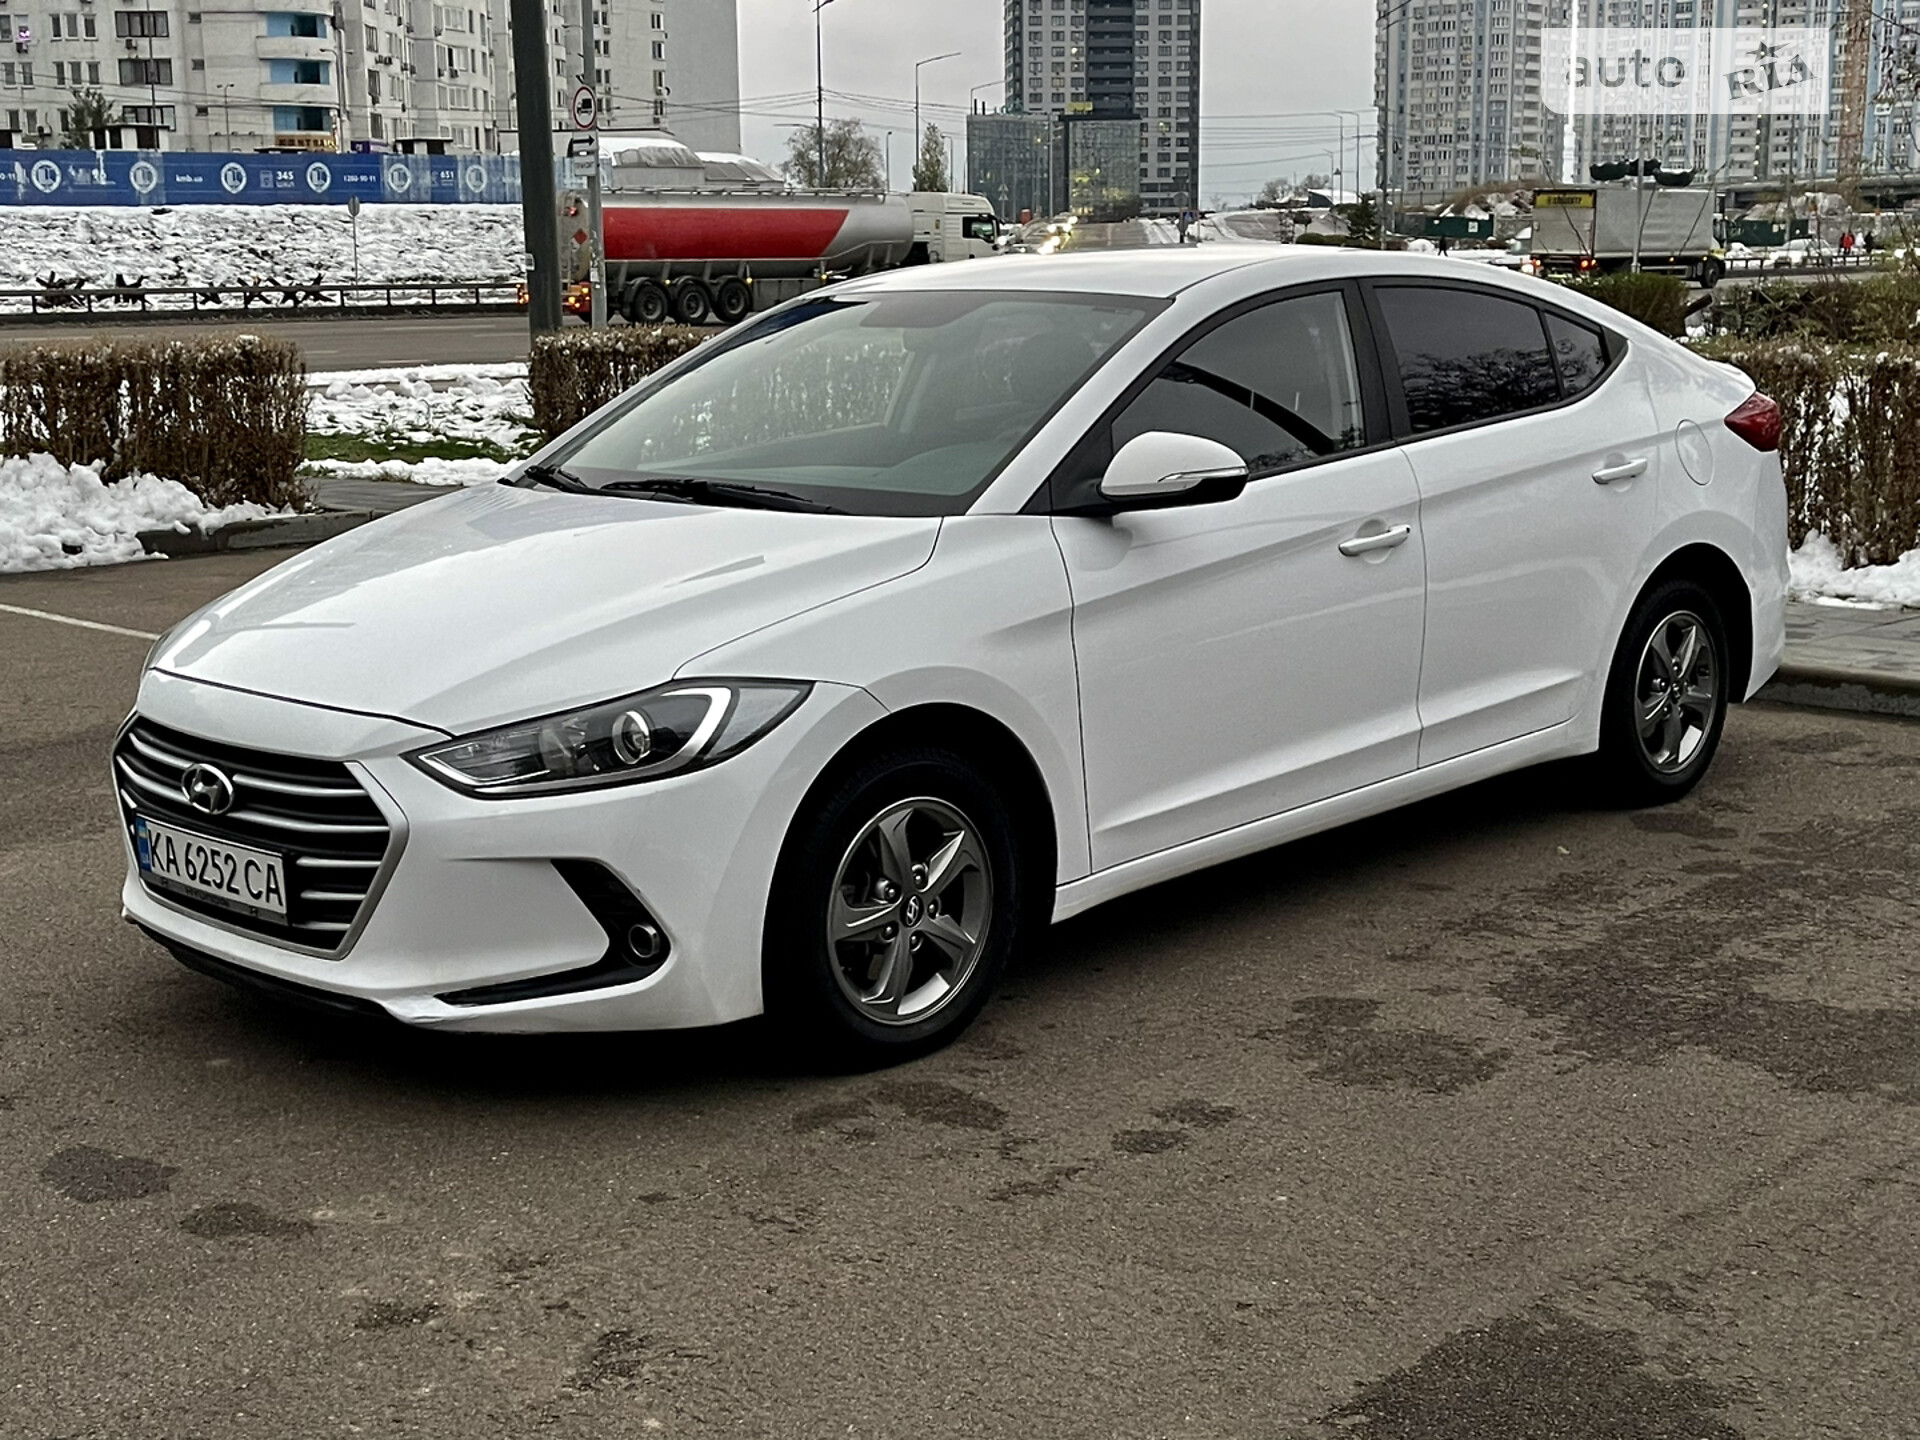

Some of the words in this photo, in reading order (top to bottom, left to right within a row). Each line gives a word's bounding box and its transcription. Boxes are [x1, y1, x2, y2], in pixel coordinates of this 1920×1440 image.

[147, 829, 180, 876] KA
[184, 842, 240, 896] 6252
[244, 858, 284, 907] CA
